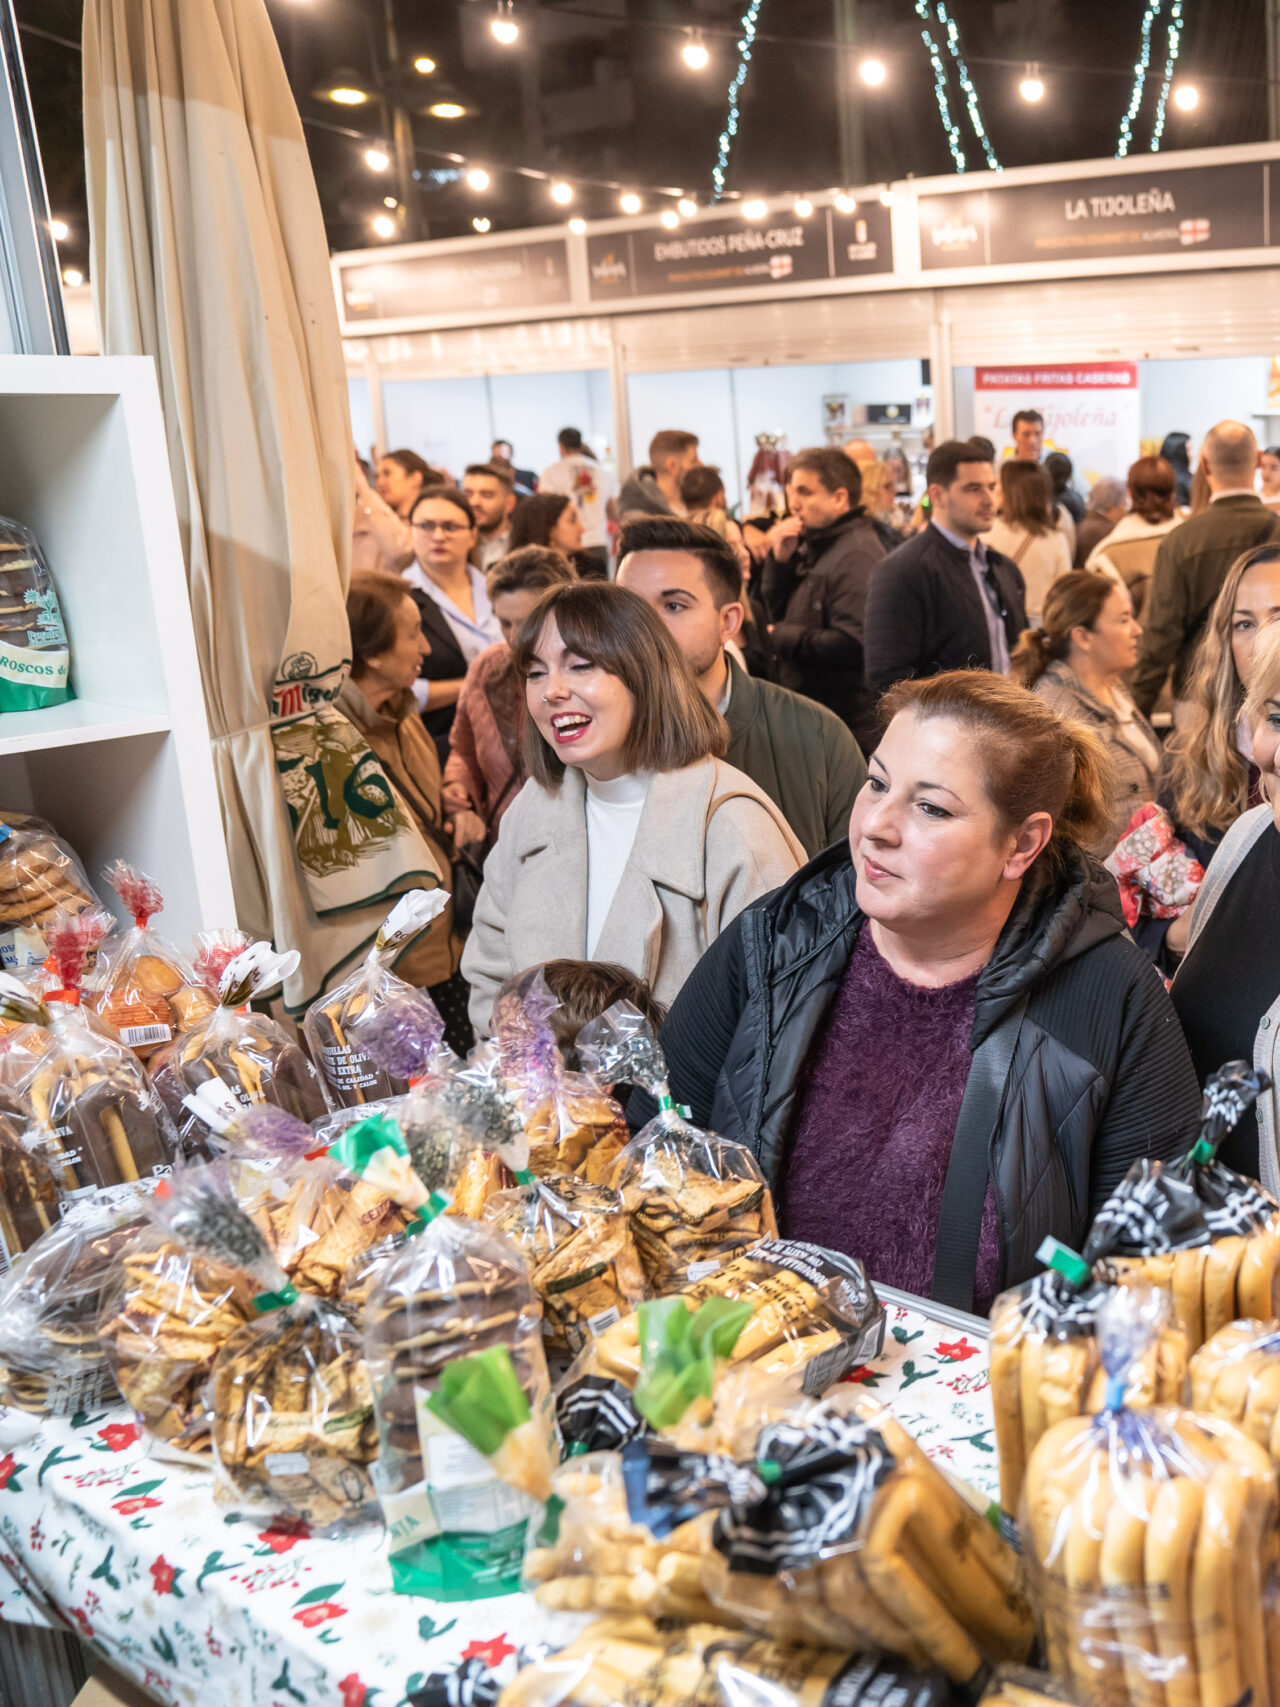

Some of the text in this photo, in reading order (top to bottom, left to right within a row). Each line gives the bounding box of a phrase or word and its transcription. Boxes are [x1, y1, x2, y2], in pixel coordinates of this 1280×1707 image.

[1065, 198, 1088, 221] LA
[728, 227, 765, 252] PEÑA
[765, 226, 804, 249] CRUZ
[349, 1052, 371, 1064] OLIV
